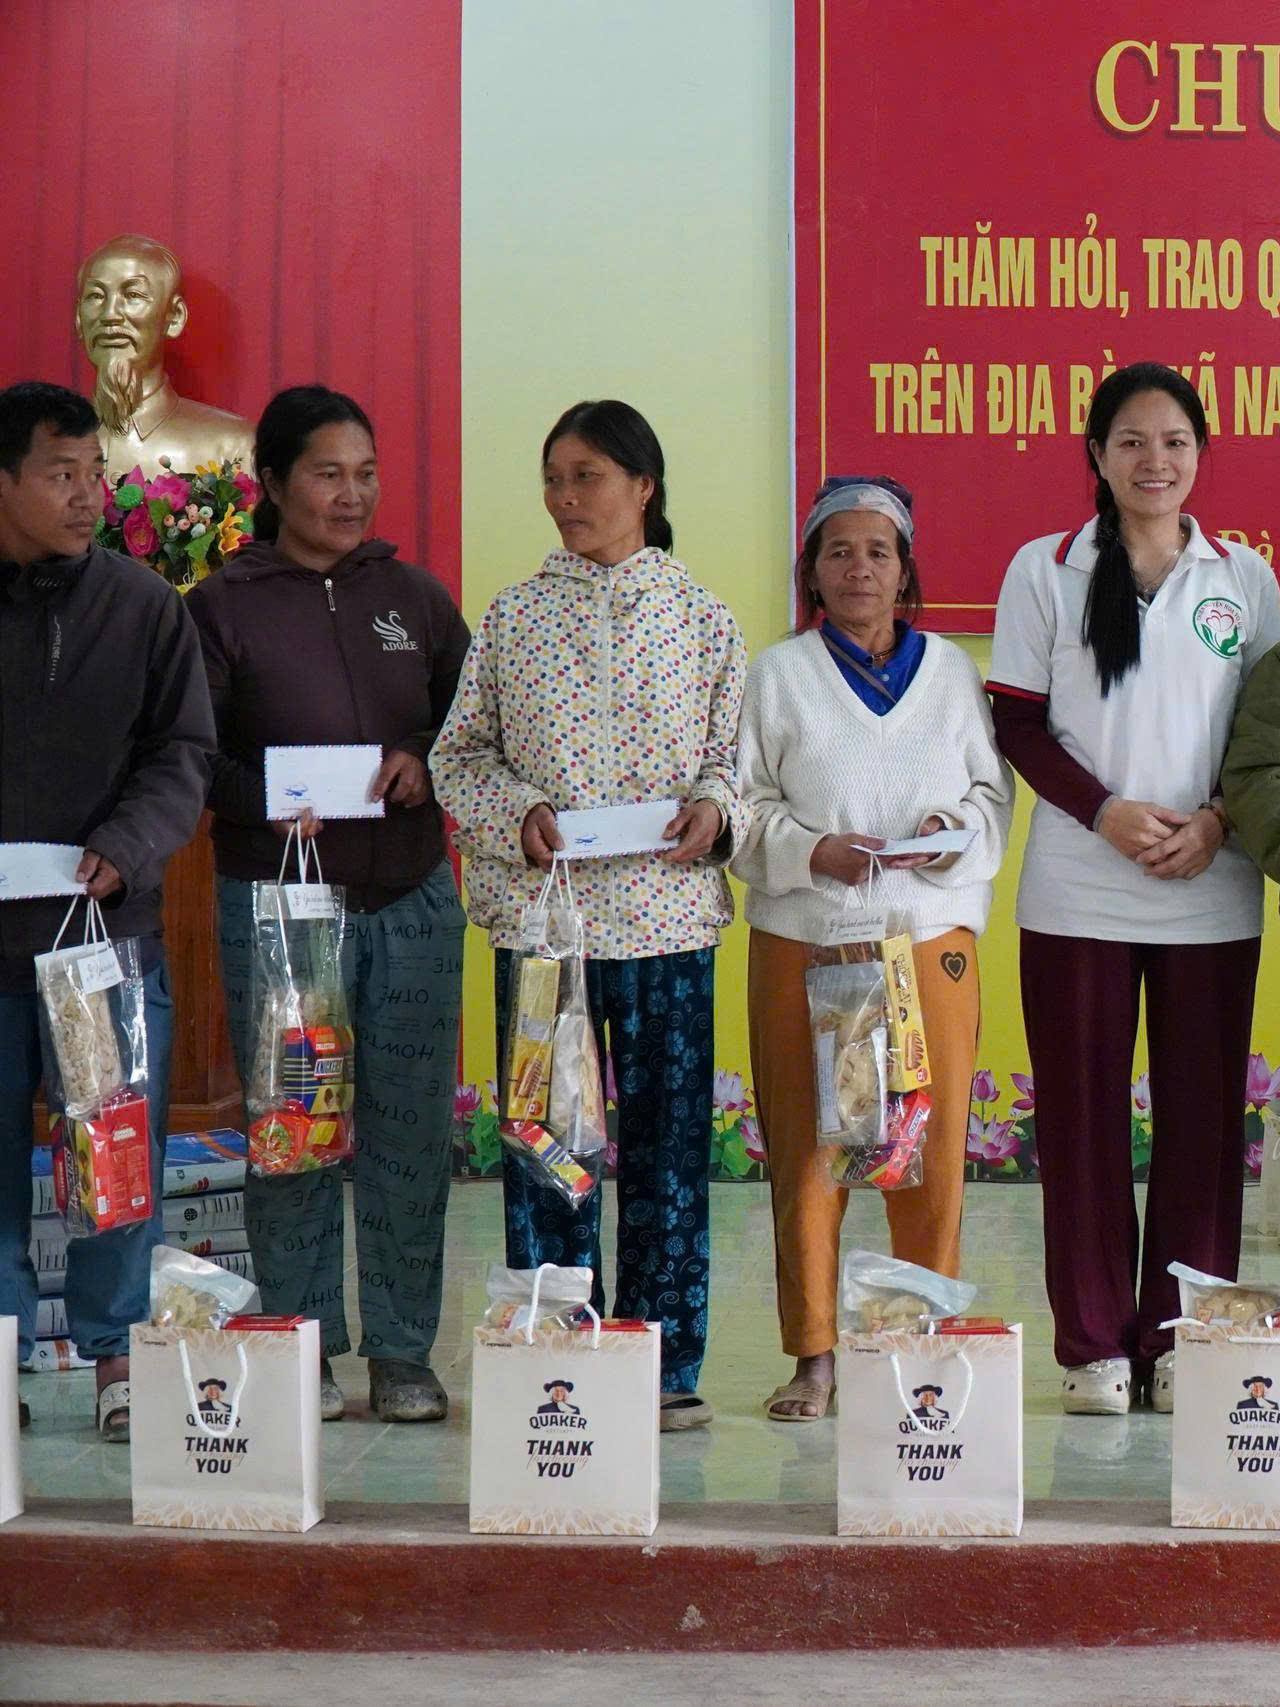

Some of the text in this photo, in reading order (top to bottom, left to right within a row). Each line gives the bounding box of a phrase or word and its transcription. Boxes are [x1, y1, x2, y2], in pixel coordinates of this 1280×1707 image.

[919, 221, 1036, 308] THĂM
[1050, 213, 1130, 318] HỎI,
[1143, 238, 1244, 310] TRAO
[869, 347, 973, 434] TRÊN
[986, 363, 1056, 452] ĐỊA
[382, 640, 419, 651] ADORE
[529, 1414, 588, 1430] QUAKER
[184, 1436, 250, 1454] THANK
[526, 1439, 594, 1456] THANK
[896, 1444, 964, 1460] THANK
[195, 1457, 232, 1474] YOU
[537, 1462, 576, 1478] YOU
[907, 1465, 945, 1481] YOU
[1237, 1456, 1274, 1473] YOU
